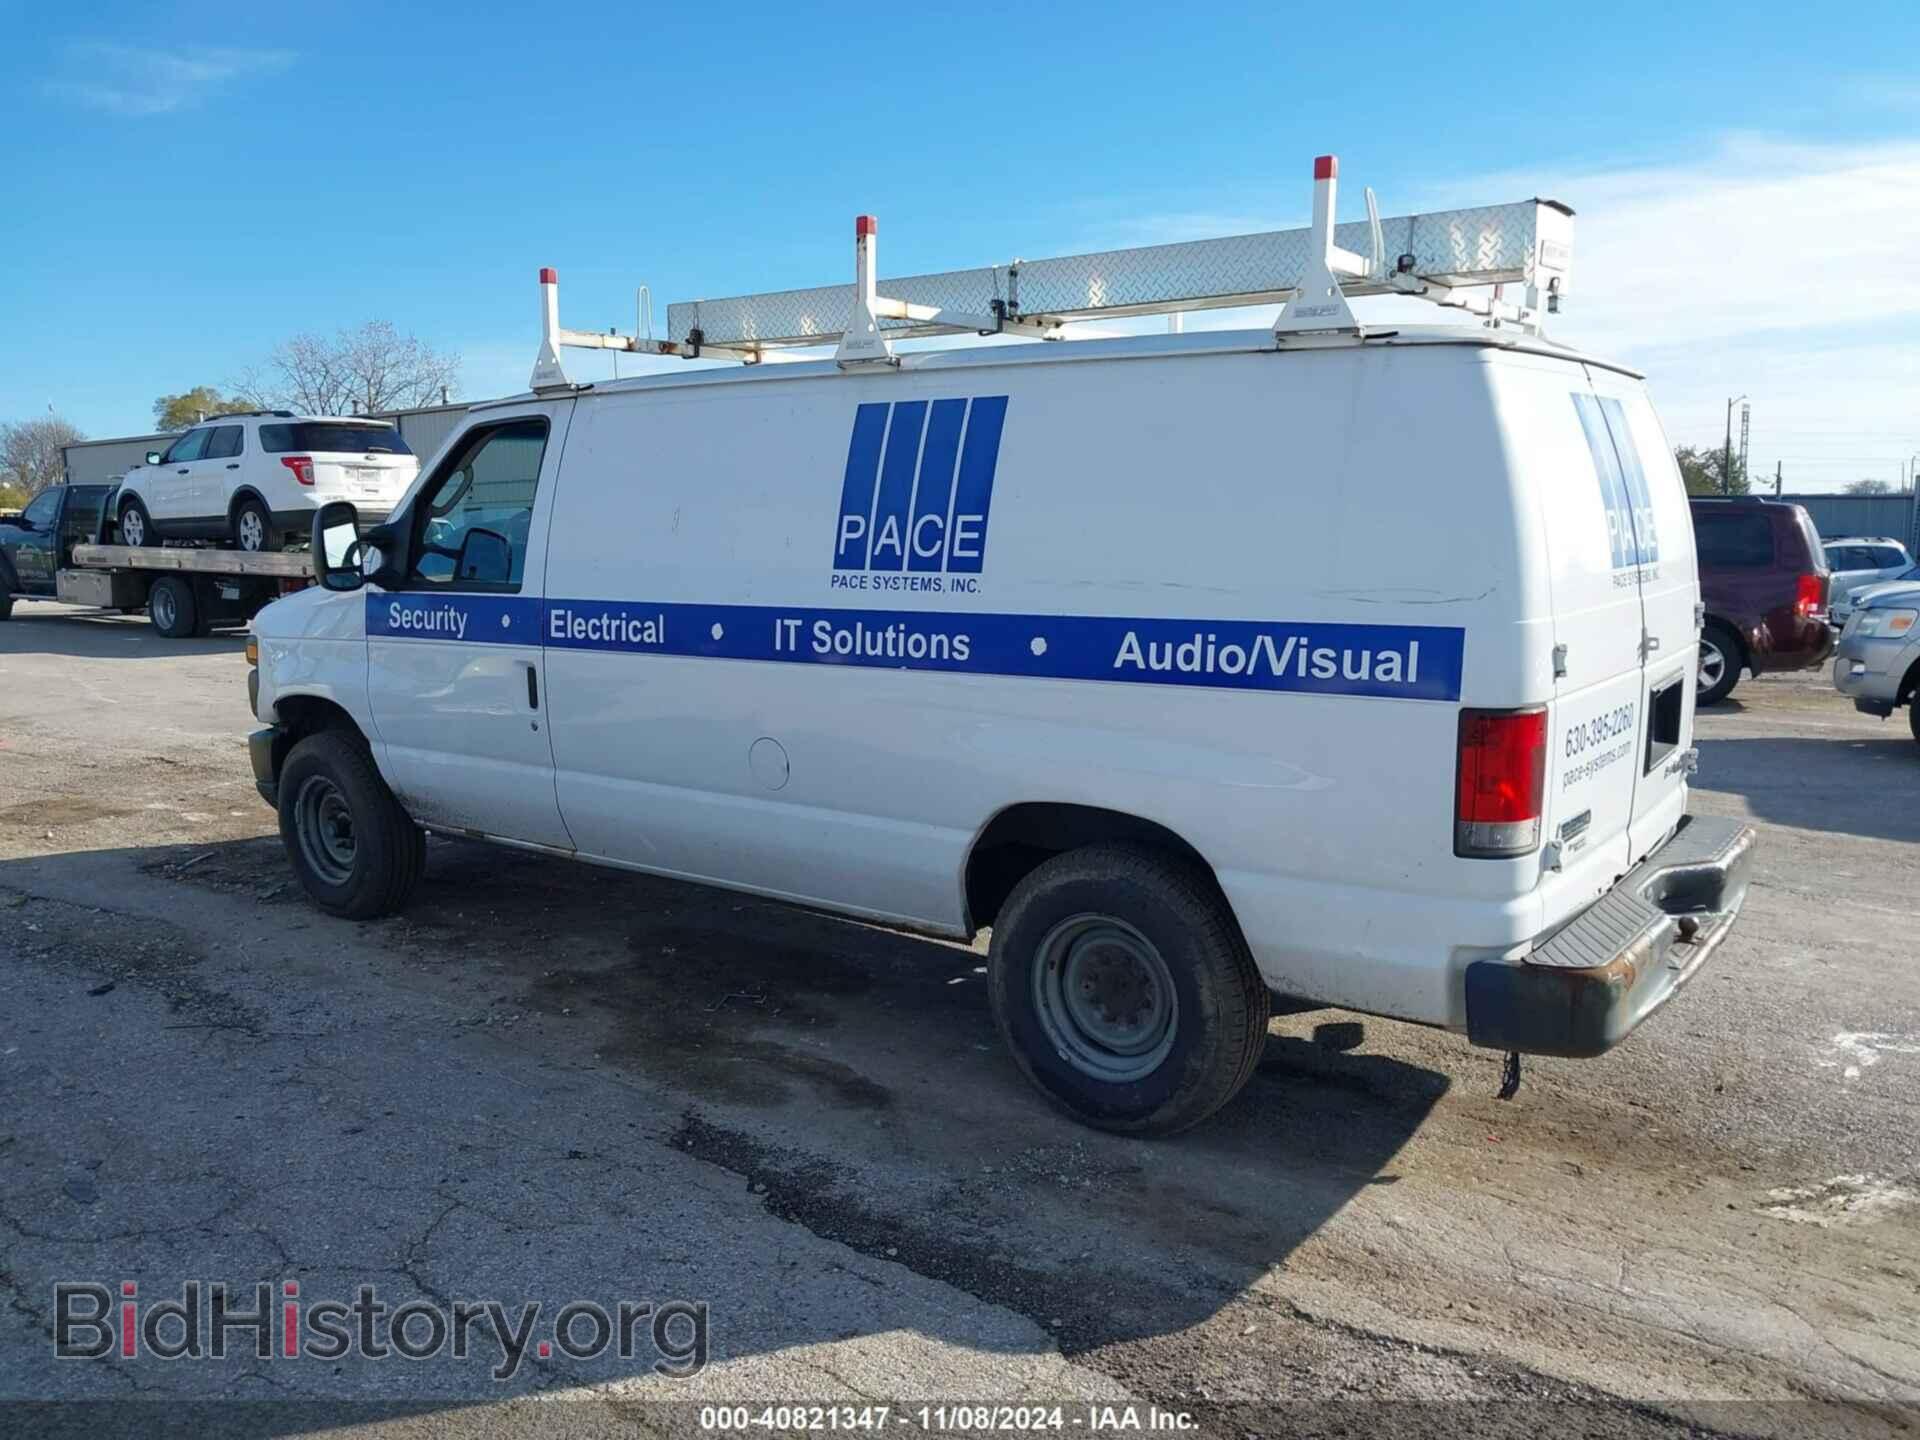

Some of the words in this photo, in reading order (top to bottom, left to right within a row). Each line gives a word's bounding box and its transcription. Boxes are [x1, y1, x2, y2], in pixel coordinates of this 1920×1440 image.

[838, 514, 984, 558] PACE
[831, 574, 868, 590] PACE
[872, 575, 946, 594] SYSTEMS,
[951, 578, 982, 593] INC.
[388, 601, 468, 638] Security
[550, 609, 665, 644] Electrical
[774, 618, 802, 651] IT
[812, 619, 971, 661] Solutions
[1113, 631, 1419, 683] Audio/Visual
[1565, 702, 1633, 758] 630-395-2260
